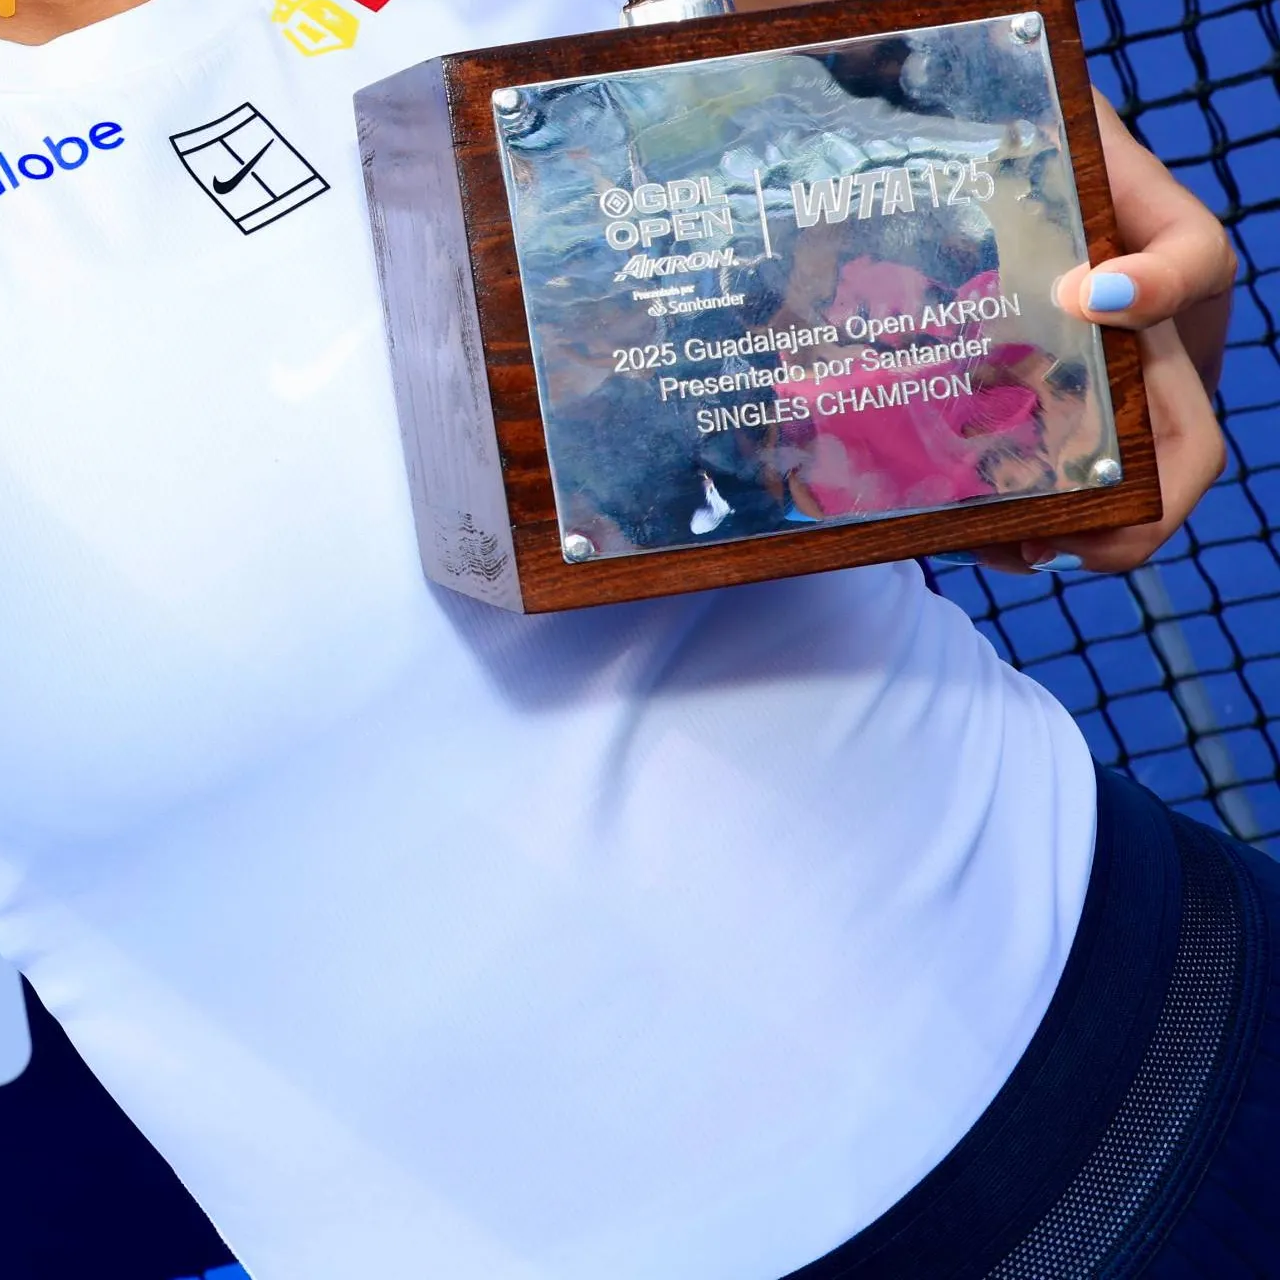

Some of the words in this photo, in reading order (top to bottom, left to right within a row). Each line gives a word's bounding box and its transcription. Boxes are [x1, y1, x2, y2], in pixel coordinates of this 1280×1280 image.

[633, 176, 729, 214] GDL
[791, 167, 915, 228] WTA
[921, 157, 995, 208] 125
[605, 207, 734, 250] OPEN
[612, 343, 677, 373] 2025
[684, 325, 838, 362] Guadalajara
[845, 314, 915, 343] Open
[920, 293, 1021, 330] AKRON
[668, 293, 745, 314] Santander
[659, 361, 806, 401] Presentado
[813, 356, 854, 385] por
[861, 336, 991, 372] Santander
[697, 396, 811, 434] SINGLES
[817, 372, 974, 416] CHAMPION
